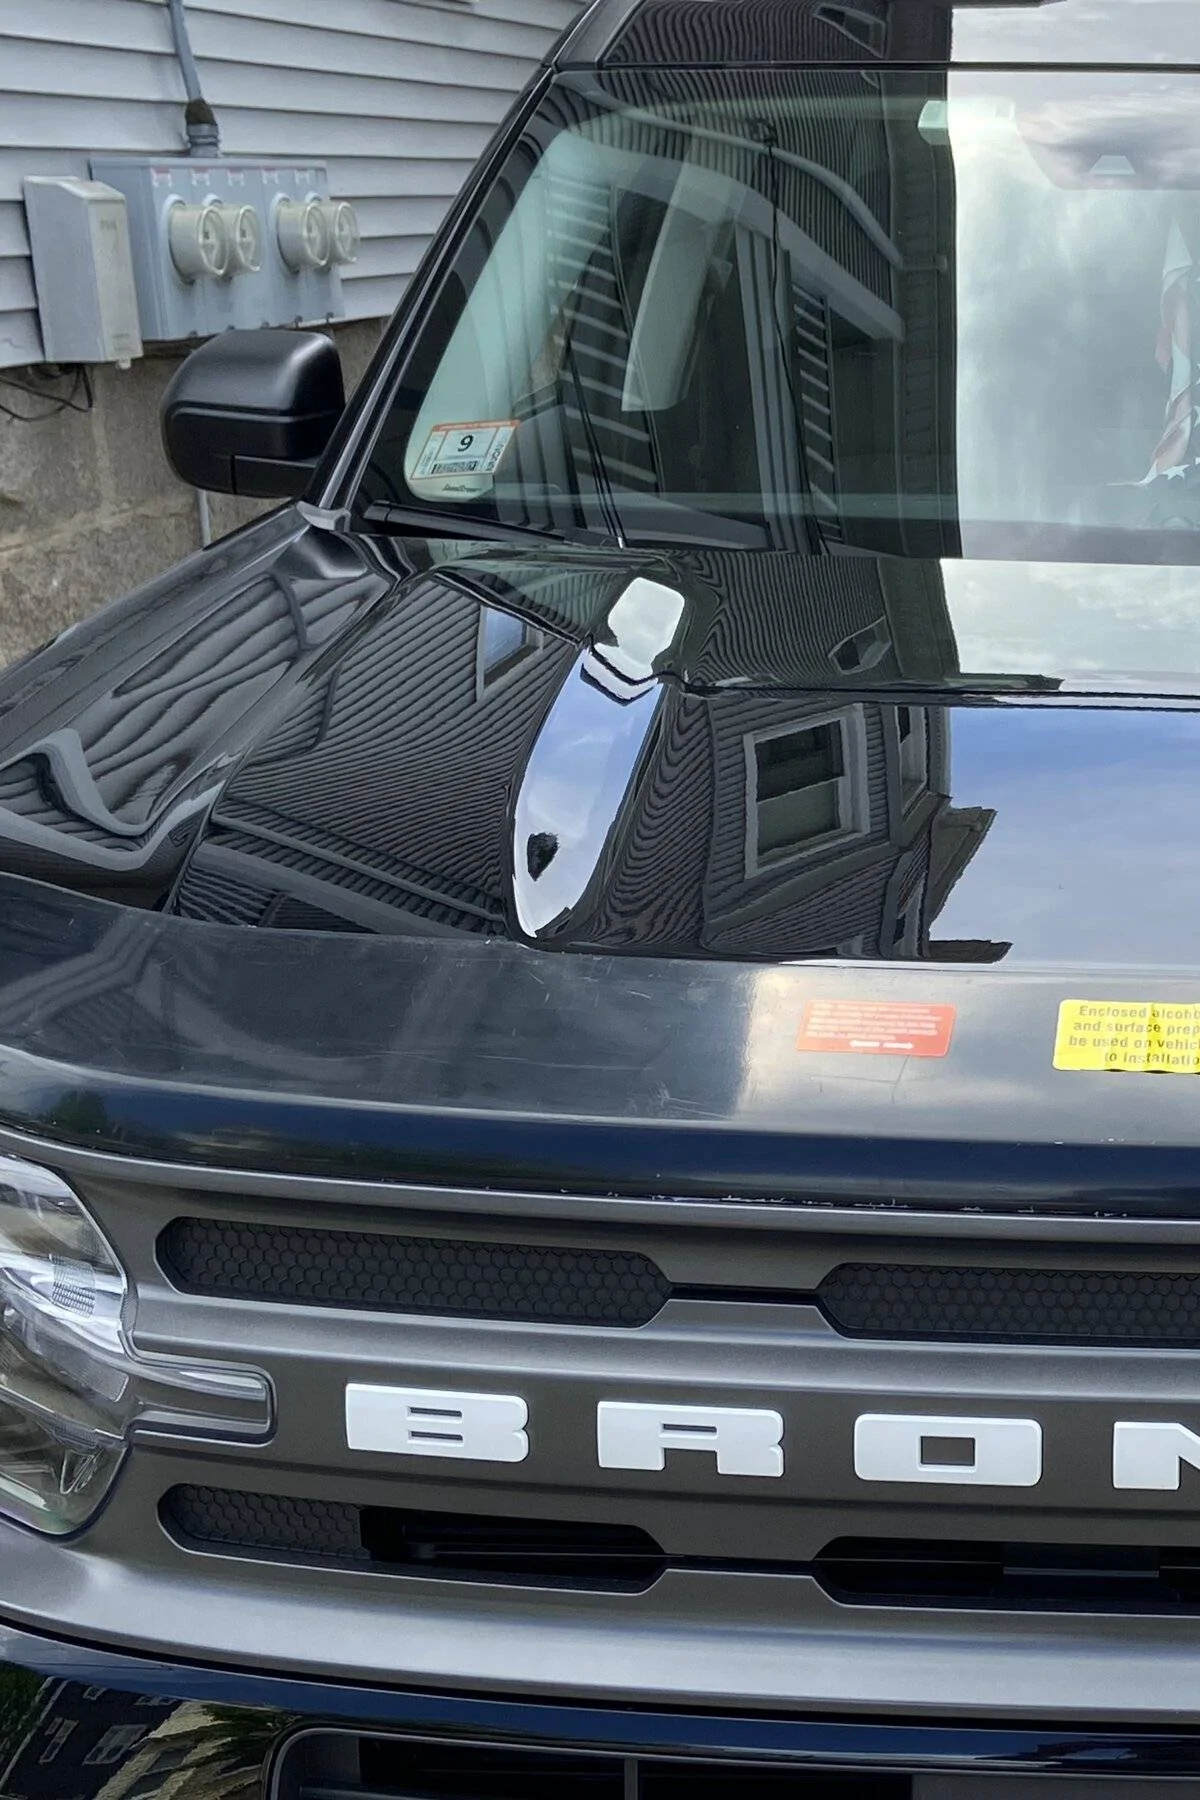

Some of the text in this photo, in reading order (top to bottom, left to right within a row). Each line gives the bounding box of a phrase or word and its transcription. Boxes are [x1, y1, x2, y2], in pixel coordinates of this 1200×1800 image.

[457, 433, 474, 453] 9
[1079, 1005, 1147, 1018] Enclosed
[1073, 1021, 1102, 1032] and
[1107, 1022, 1161, 1033] surface
[1167, 1025, 1200, 1036] prep
[1069, 1035, 1087, 1046] be
[1093, 1036, 1128, 1048] used
[1134, 1038, 1152, 1048] on
[1105, 1052, 1118, 1062] to
